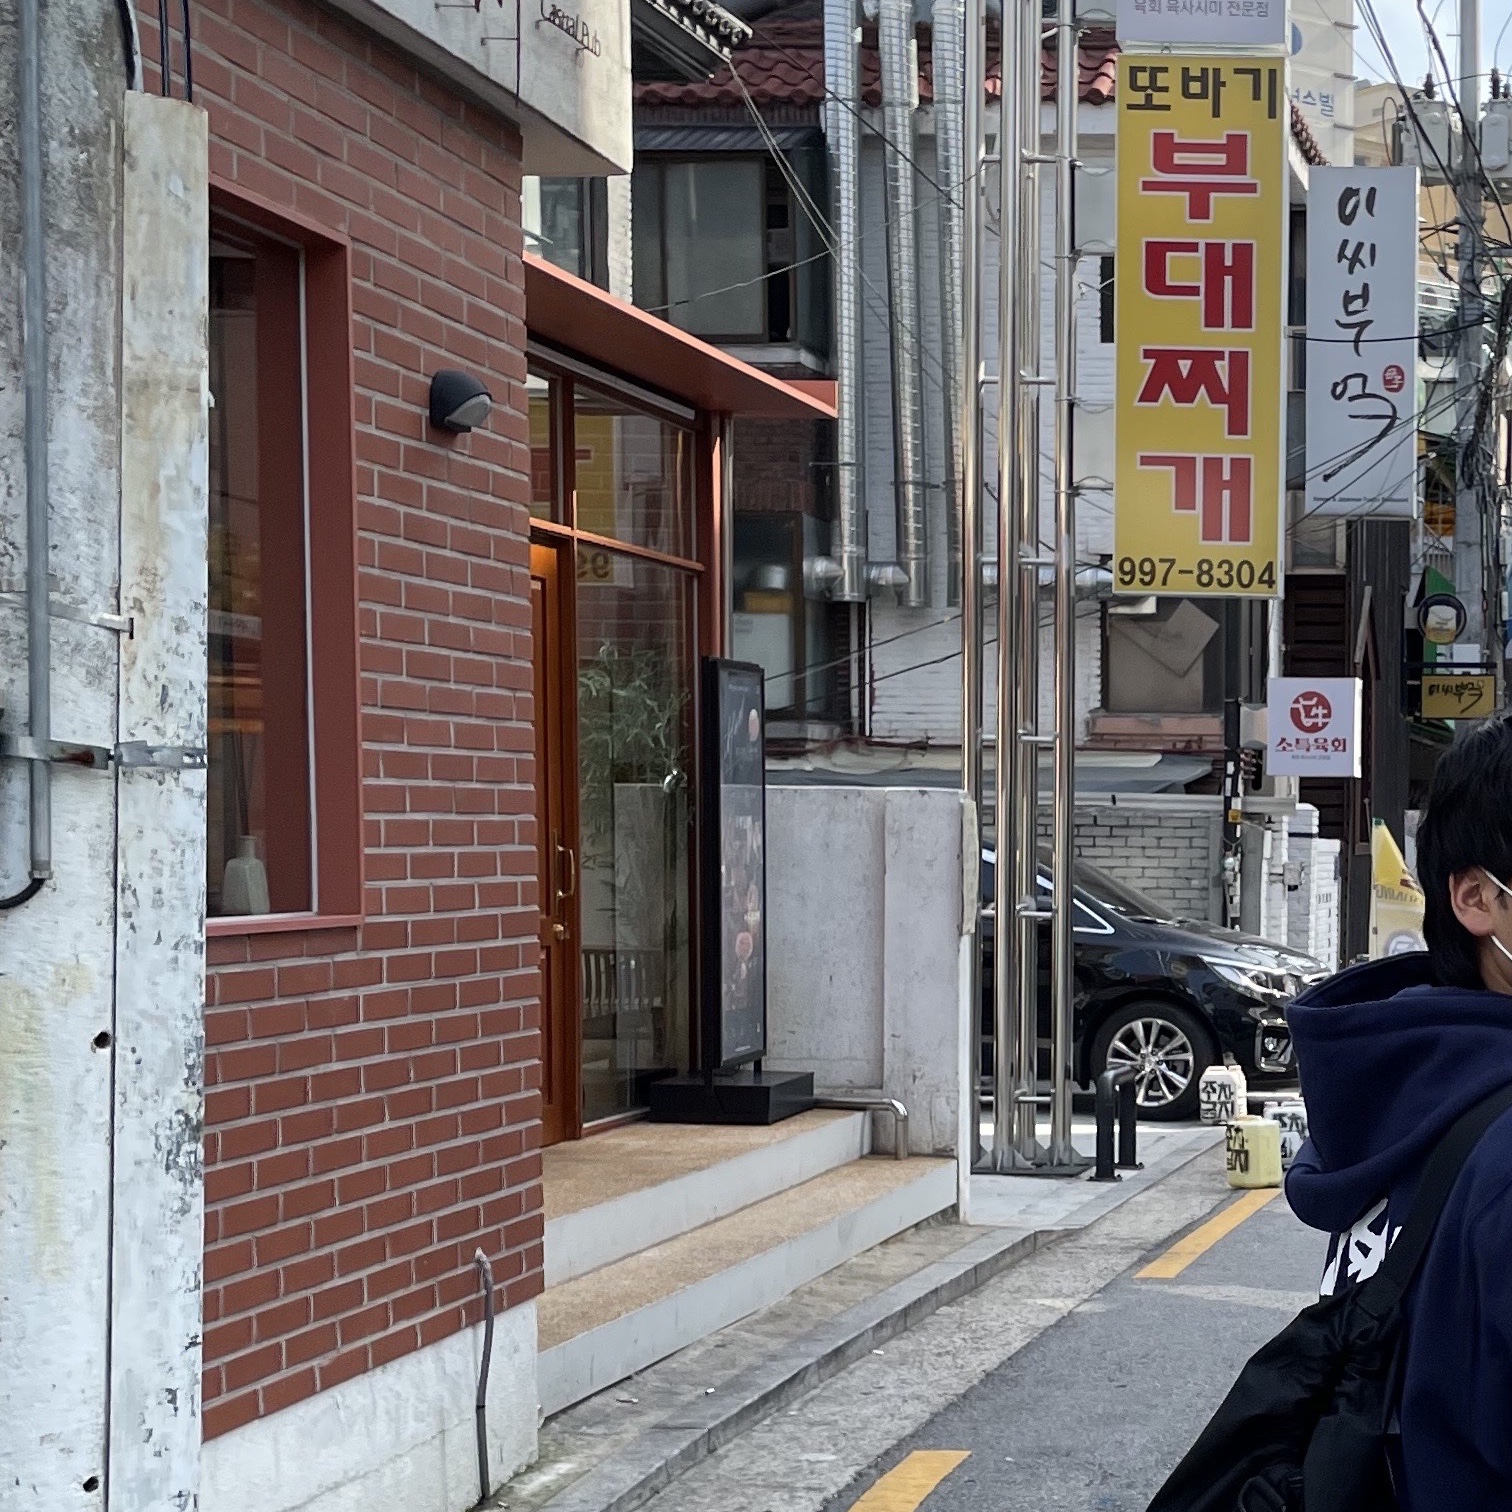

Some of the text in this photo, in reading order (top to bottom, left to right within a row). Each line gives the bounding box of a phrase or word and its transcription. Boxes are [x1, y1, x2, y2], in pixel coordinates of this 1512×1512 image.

[1227, 0, 1269, 17] 전문점
[1126, 65, 1278, 119] 또바기
[1138, 129, 1261, 546] 부대찌개
[1118, 556, 1276, 589] 997-8304
[1201, 1080, 1234, 1101] 주차
